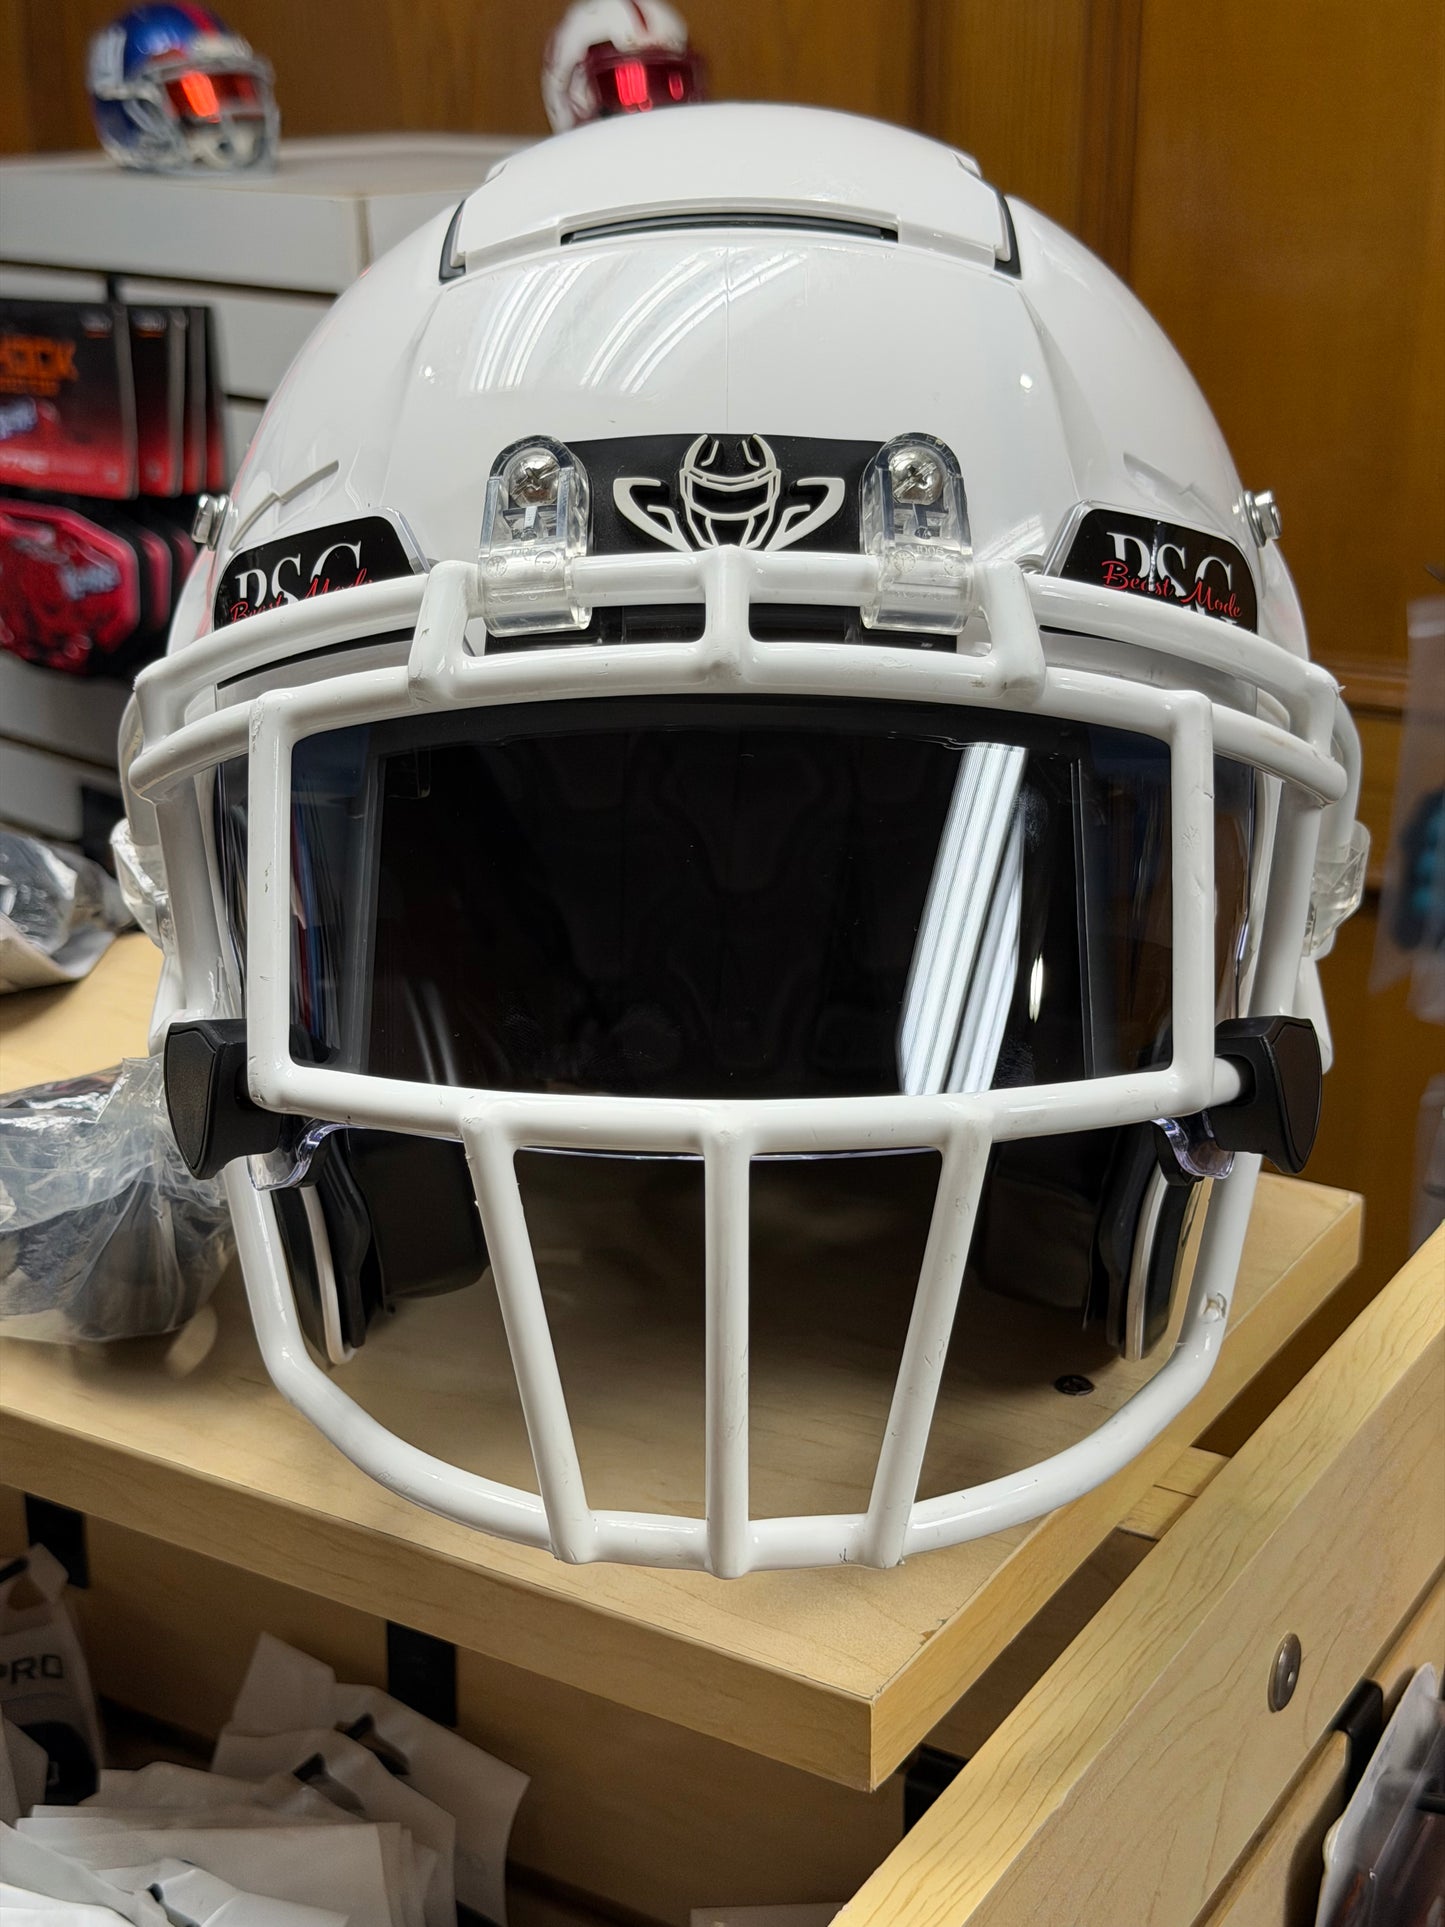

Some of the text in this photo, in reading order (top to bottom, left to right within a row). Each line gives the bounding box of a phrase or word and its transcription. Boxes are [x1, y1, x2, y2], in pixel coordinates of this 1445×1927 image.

[304, 568, 374, 600] Md
[1101, 560, 1243, 618] Beast Mode
